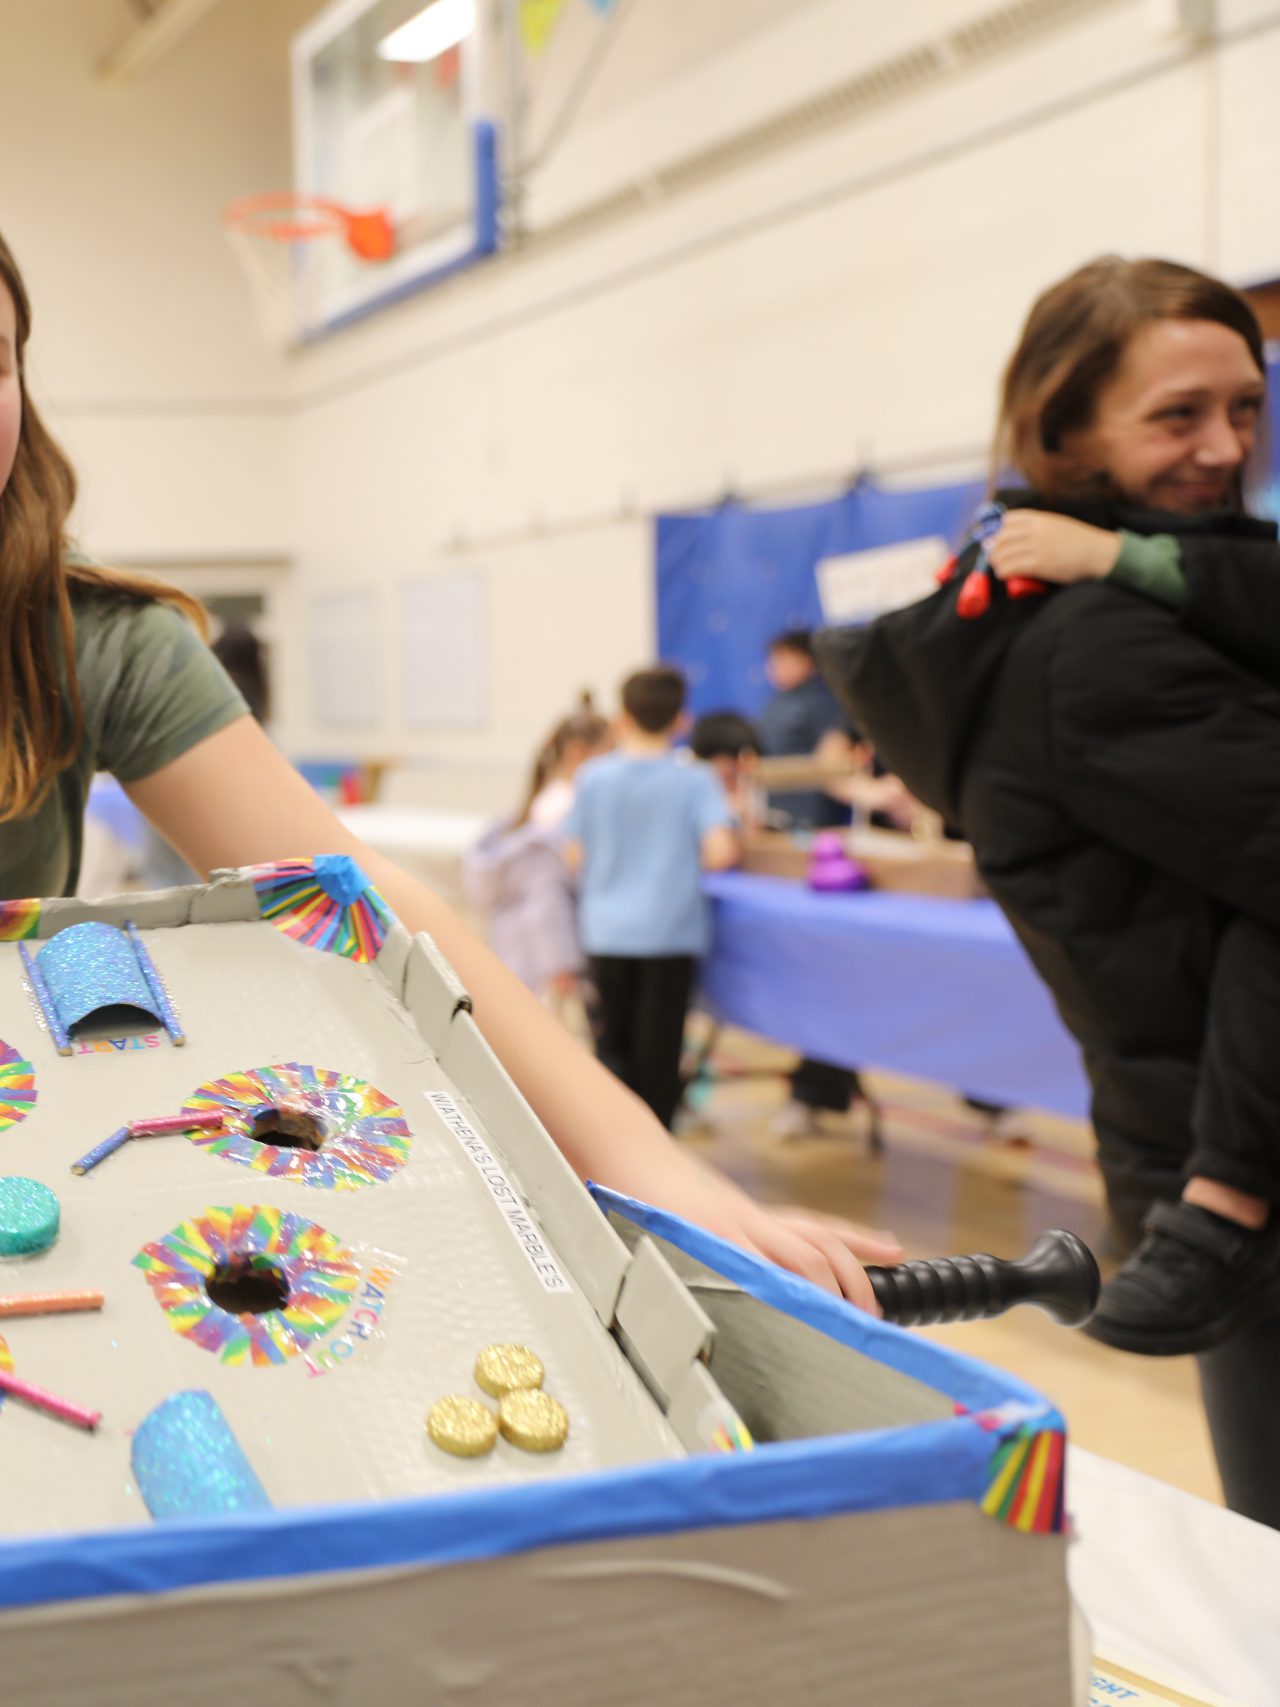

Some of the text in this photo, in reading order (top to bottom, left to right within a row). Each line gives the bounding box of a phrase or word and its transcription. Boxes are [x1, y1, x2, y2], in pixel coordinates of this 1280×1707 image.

[77, 1035, 161, 1055] START
[481, 1168, 518, 1205] LOST
[306, 1266, 397, 1379] WATCH OUT
